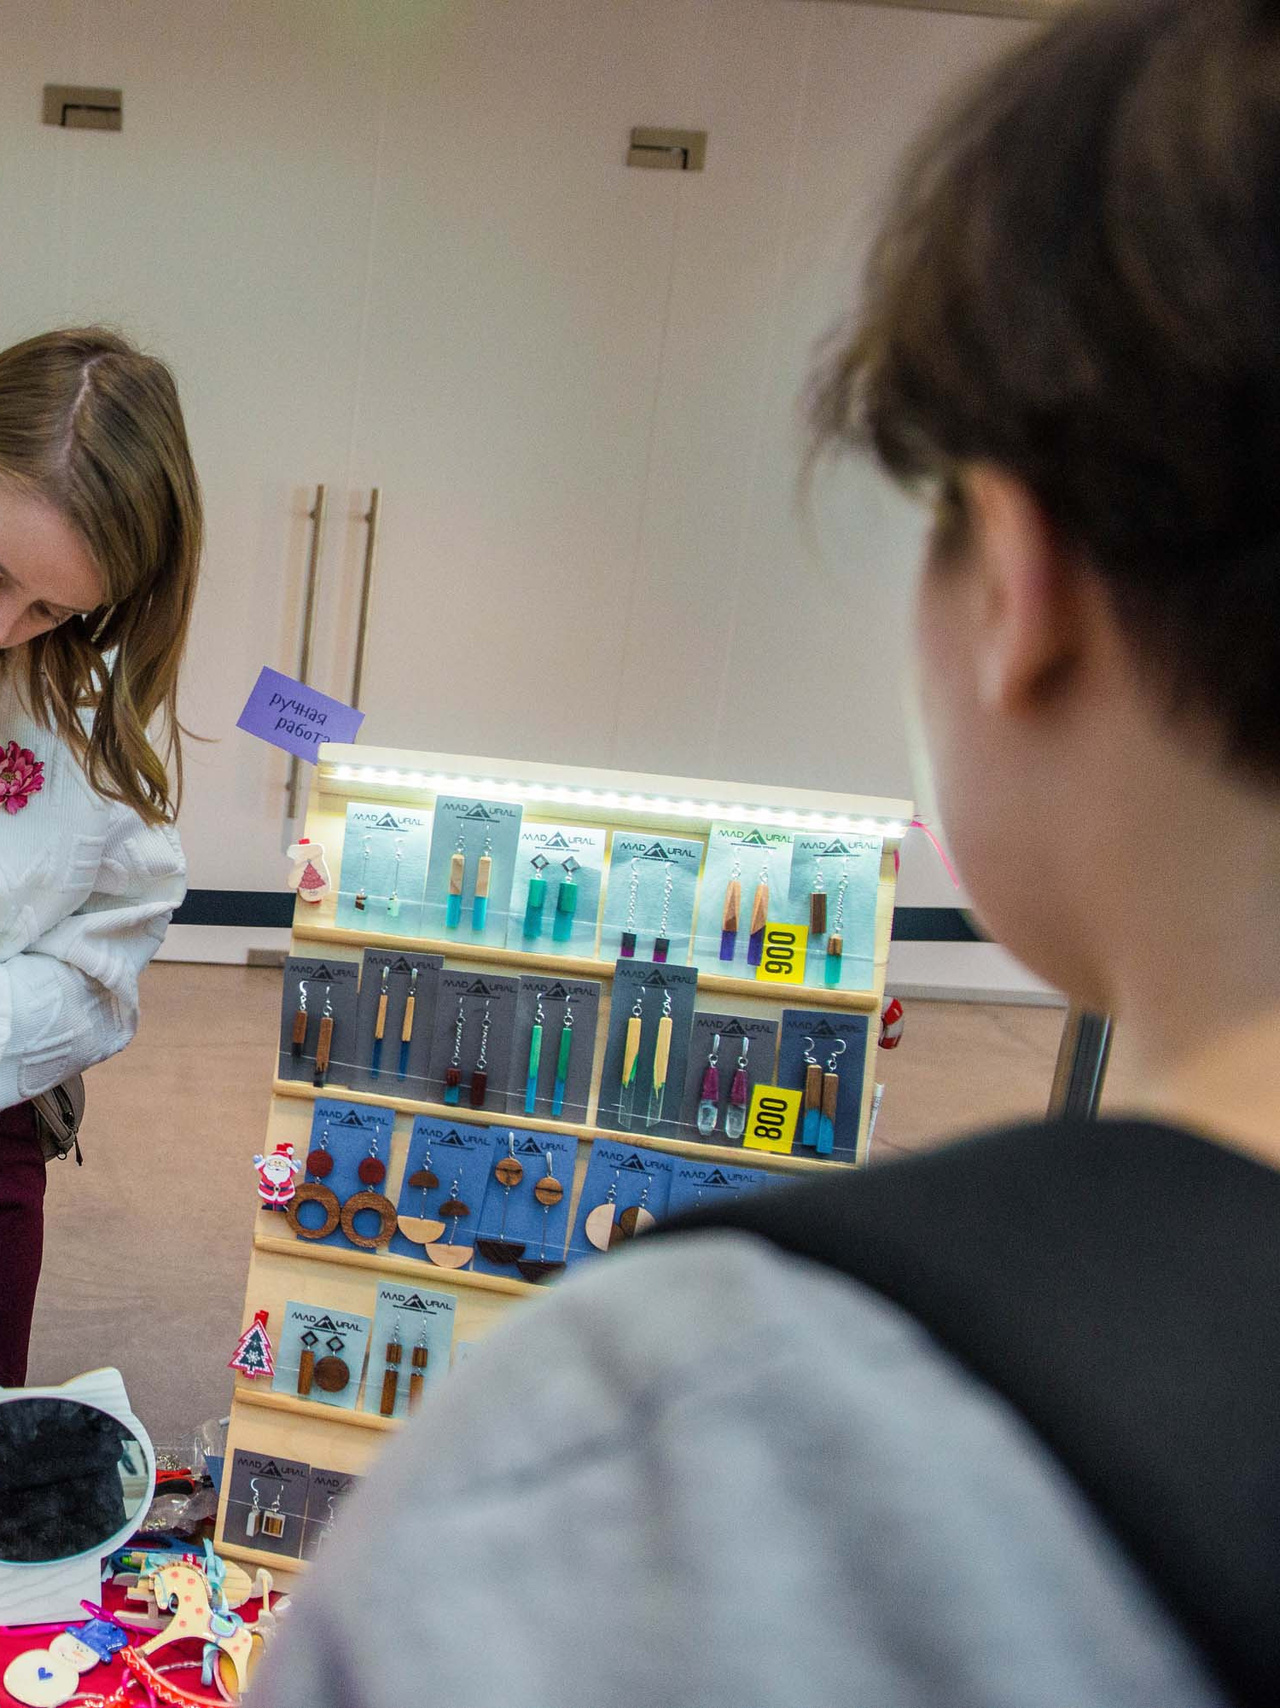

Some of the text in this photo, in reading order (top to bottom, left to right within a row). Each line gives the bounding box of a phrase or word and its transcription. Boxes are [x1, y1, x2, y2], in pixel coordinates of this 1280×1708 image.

[269, 692, 328, 726] ручная
[353, 812, 379, 822] MAD
[443, 803, 516, 818] MAD URAL
[522, 832, 595, 846] MAD URAL
[620, 842, 695, 858] MAD URAL
[765, 931, 796, 975] 900
[318, 1109, 343, 1119] MAD
[754, 1097, 788, 1141] 800
[417, 1127, 443, 1138] MAD
[597, 1150, 622, 1162] MAD
[645, 1160, 673, 1172] URAL
[679, 1170, 756, 1183] MAD URAL
[380, 1291, 406, 1302] MAD
[425, 1299, 453, 1311] URAL
[291, 1311, 317, 1323] MAD
[335, 1320, 363, 1332] URAL
